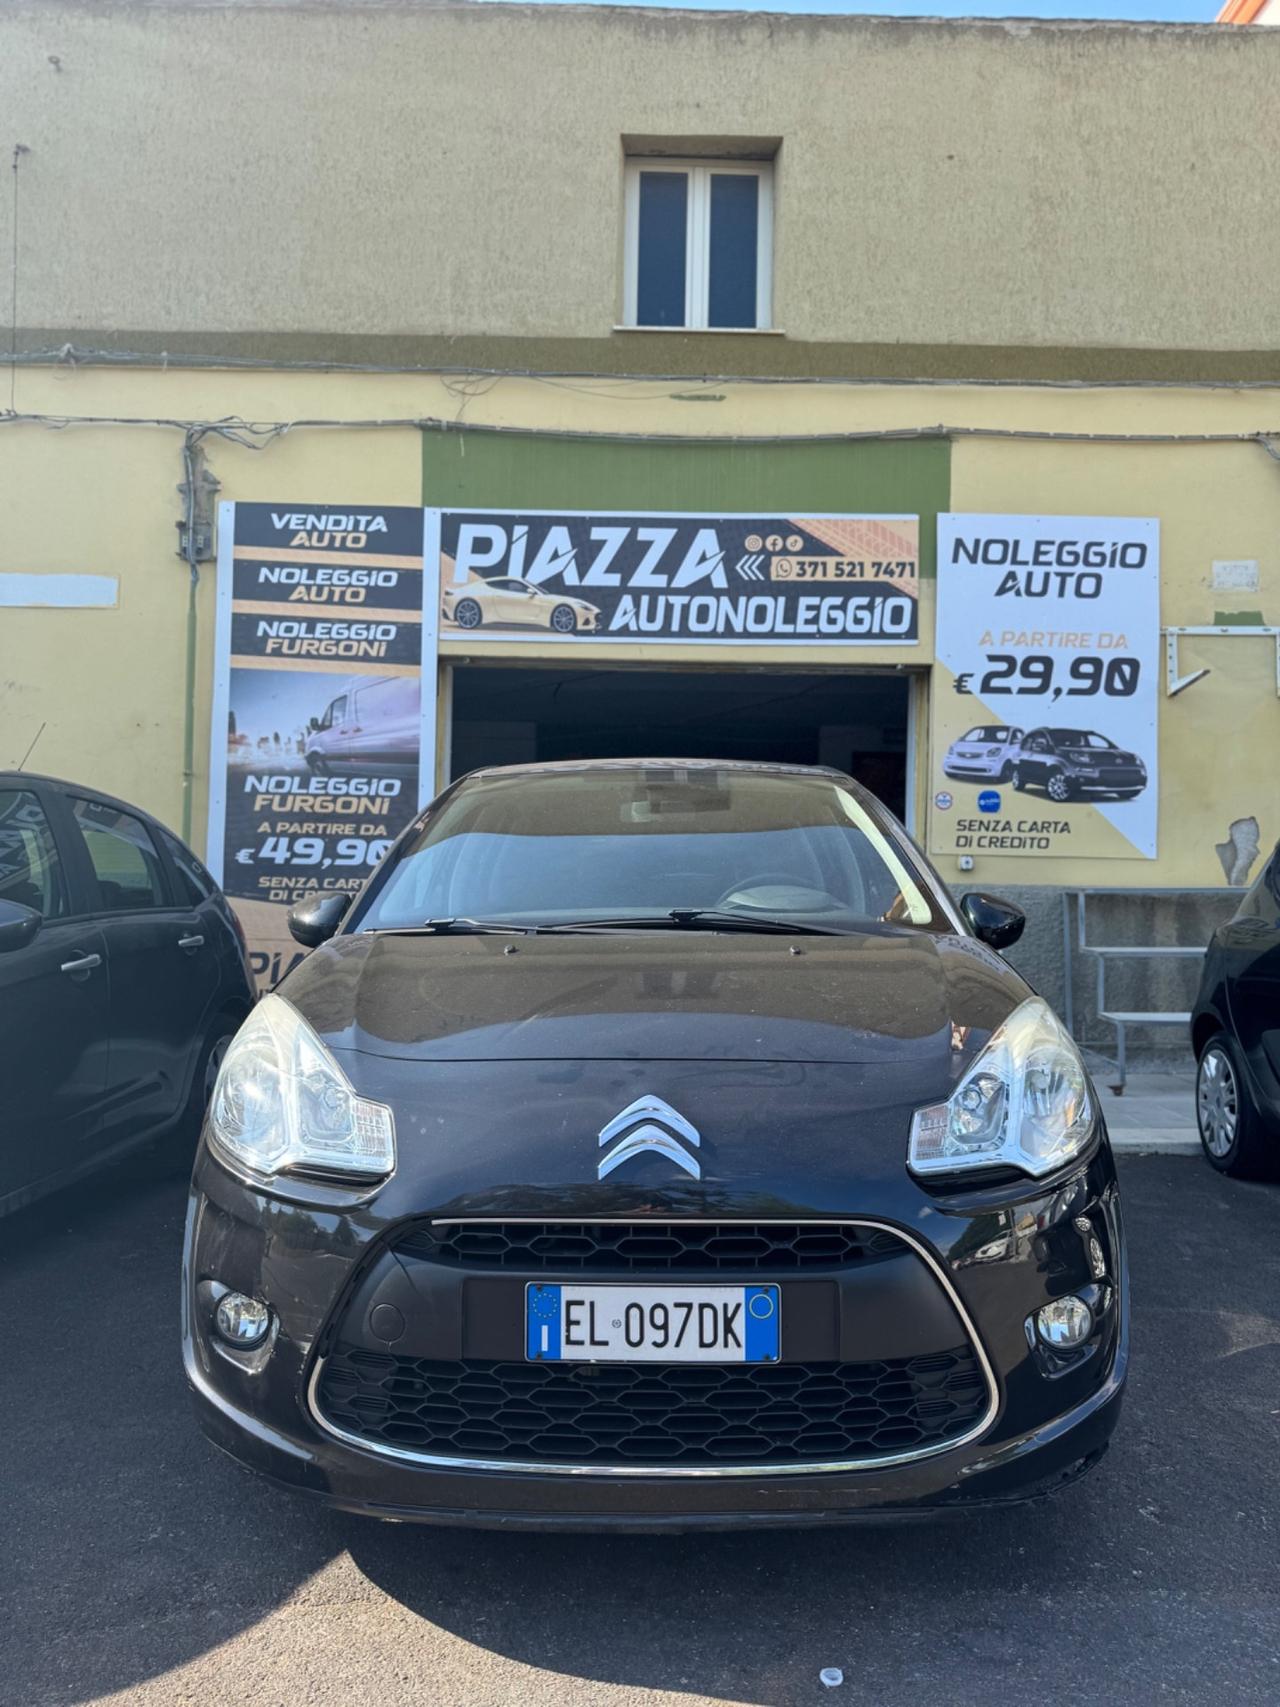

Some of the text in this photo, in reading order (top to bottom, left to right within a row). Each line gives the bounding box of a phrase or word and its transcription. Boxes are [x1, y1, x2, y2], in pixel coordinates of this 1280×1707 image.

[290, 531, 367, 548] AUTO
[795, 561, 916, 578] 371 521 7471
[994, 571, 1103, 599] AUTO
[288, 585, 366, 603] AUTO
[978, 630, 994, 646] A
[1097, 633, 1128, 649] DA
[257, 821, 387, 836] A PARTIRE DA
[956, 819, 1071, 834] SENZA CARTA
[258, 876, 370, 889] SENZA CART
[269, 889, 288, 900] DI
[565, 1300, 743, 1349] EL 097DK
